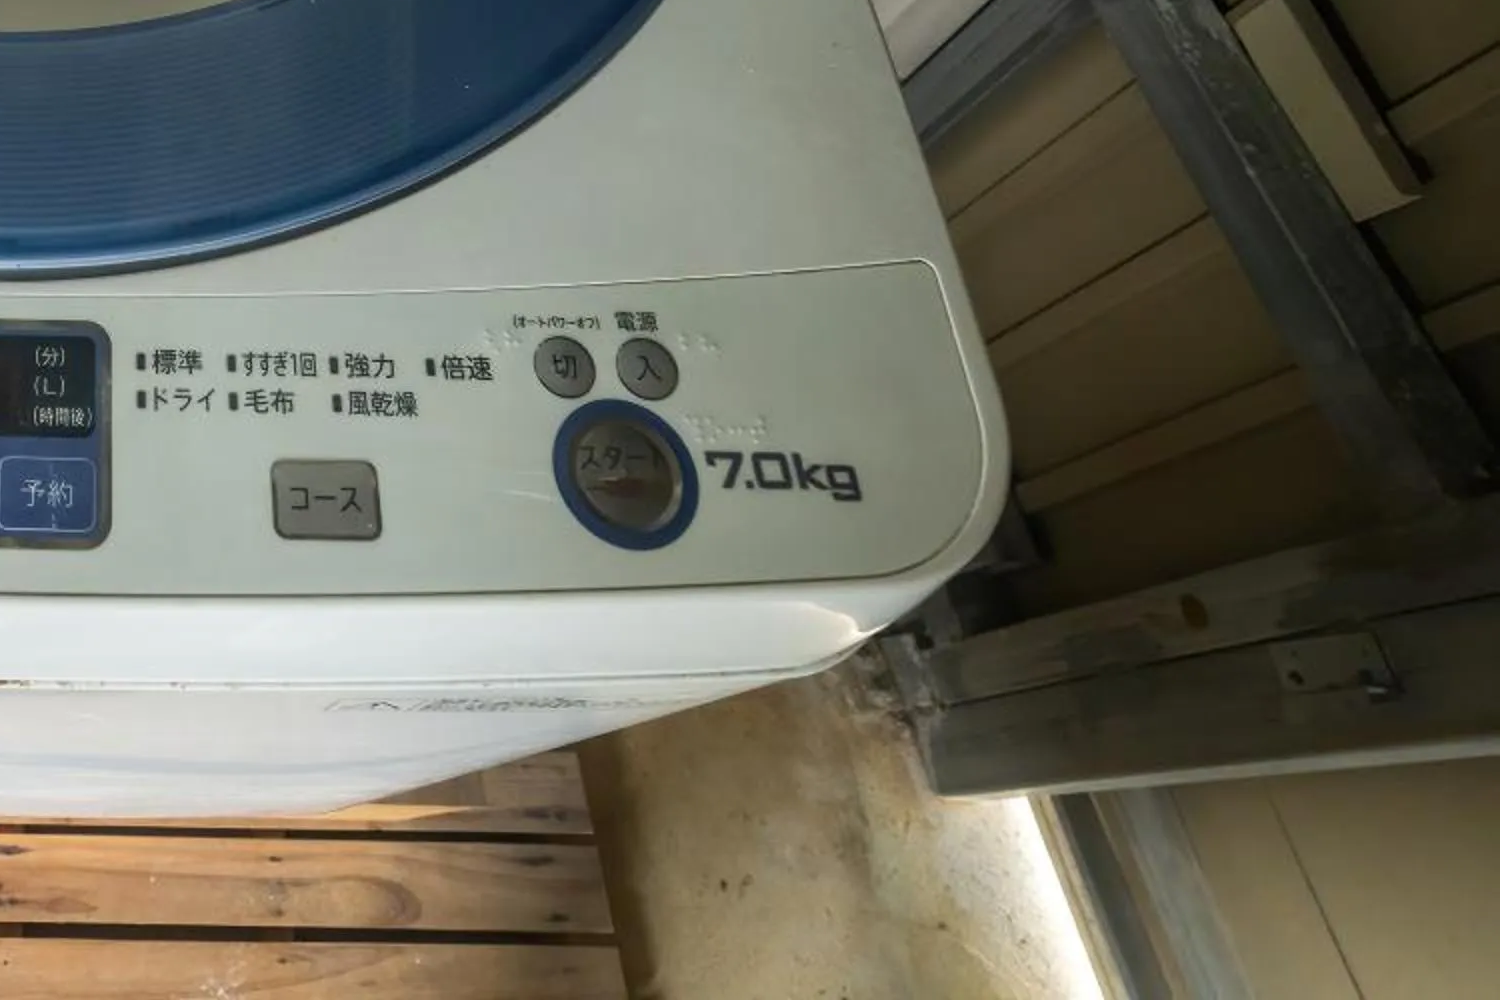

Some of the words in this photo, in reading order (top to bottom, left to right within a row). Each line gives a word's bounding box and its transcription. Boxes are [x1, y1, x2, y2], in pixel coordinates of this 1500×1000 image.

[614, 311, 659, 332] 電源
[35, 346, 66, 367] (分)
[152, 350, 203, 376] 標準
[243, 352, 318, 378] すすぎ1回
[345, 353, 396, 380] 強力
[442, 355, 495, 381] 倍速
[552, 353, 578, 380] 切
[636, 354, 663, 381] 入
[33, 377, 66, 397] (L)
[153, 386, 216, 412] ドライ
[244, 389, 296, 415] 毛布
[348, 391, 420, 417] 風乾燥
[33, 406, 93, 427] (時間後)
[704, 450, 864, 502] 7.0kg
[20, 478, 74, 509] 予約
[289, 487, 363, 513] コース
